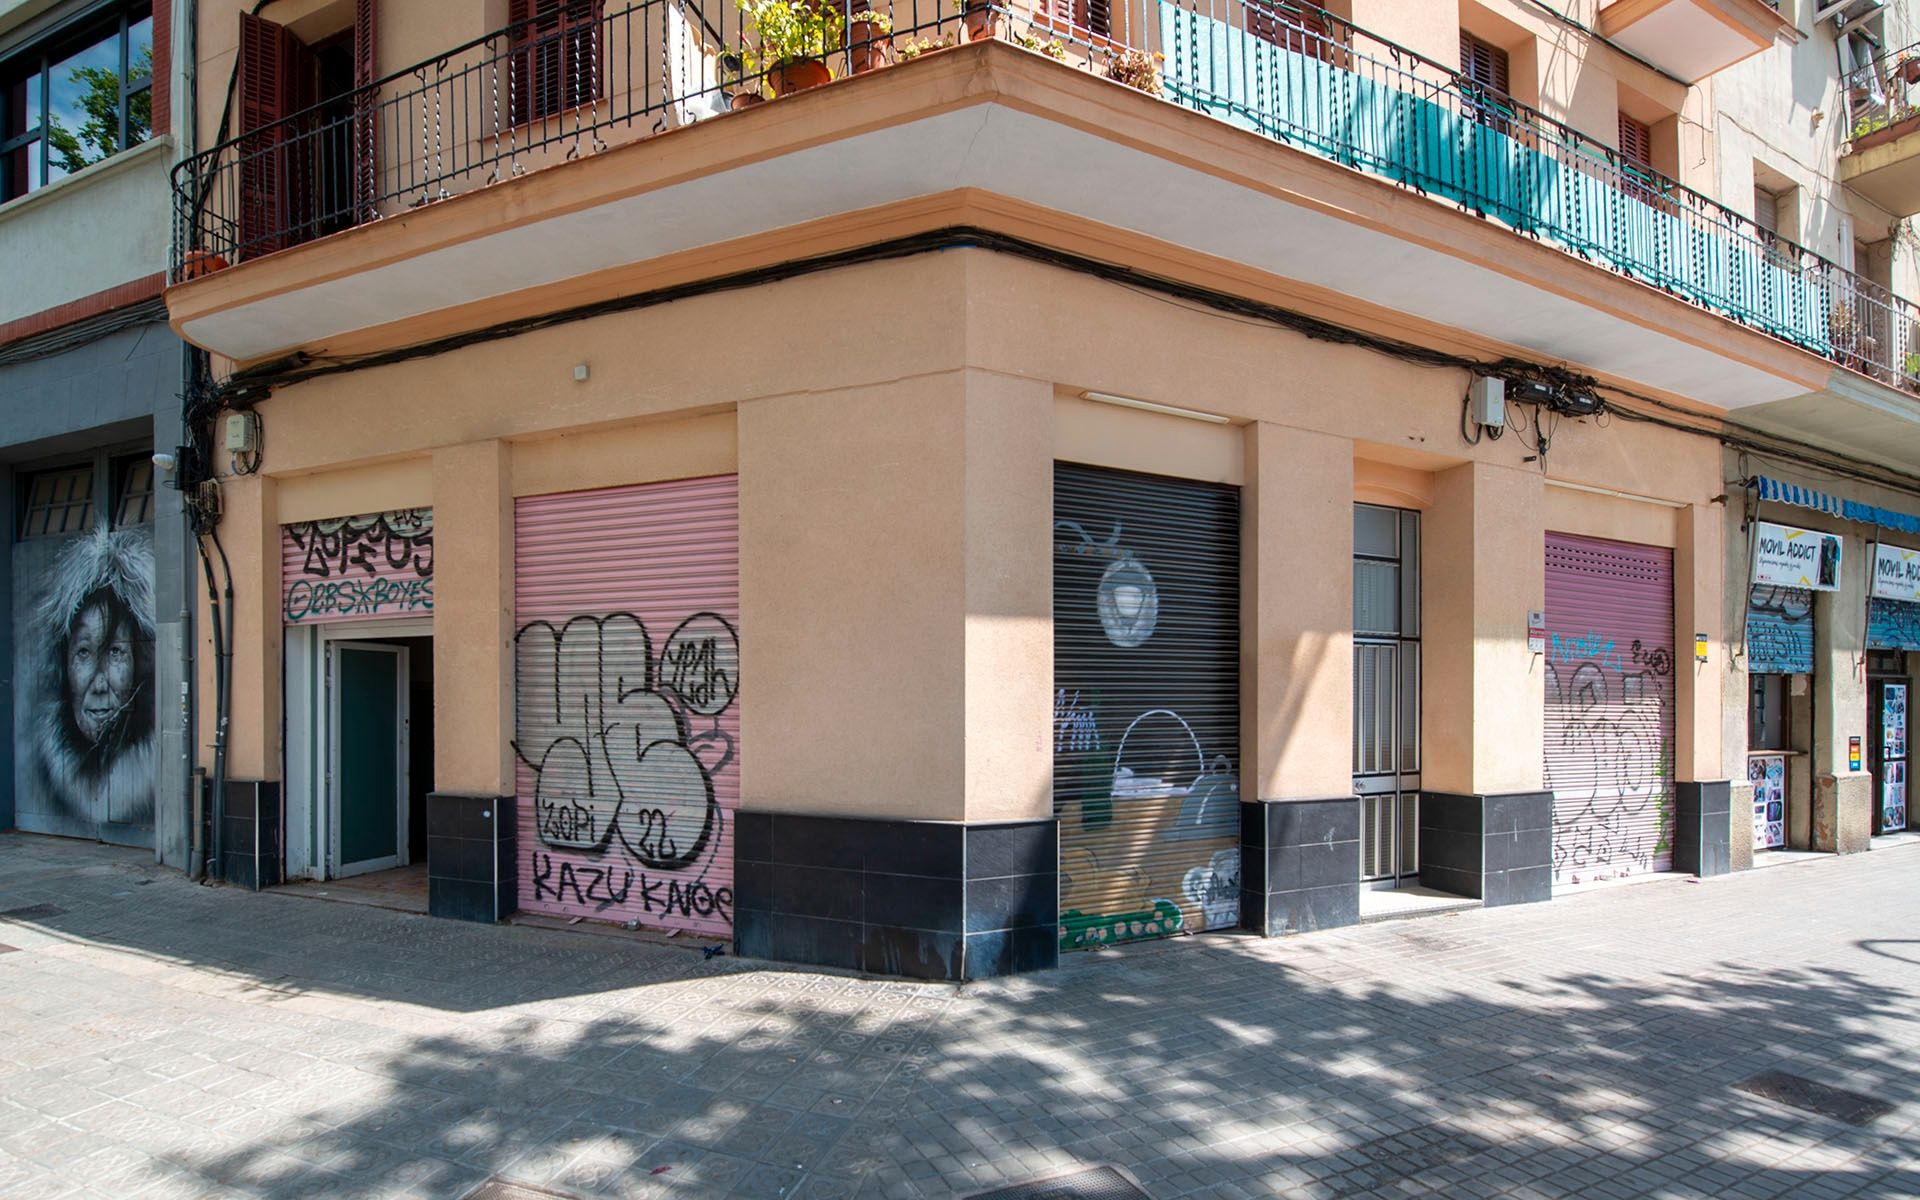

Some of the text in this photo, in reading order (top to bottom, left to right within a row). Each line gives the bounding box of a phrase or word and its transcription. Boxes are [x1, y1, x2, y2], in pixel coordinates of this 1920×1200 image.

[1760, 537, 1816, 562] MOVIL ADDICT
[1878, 558, 1904, 579] MOVIL
